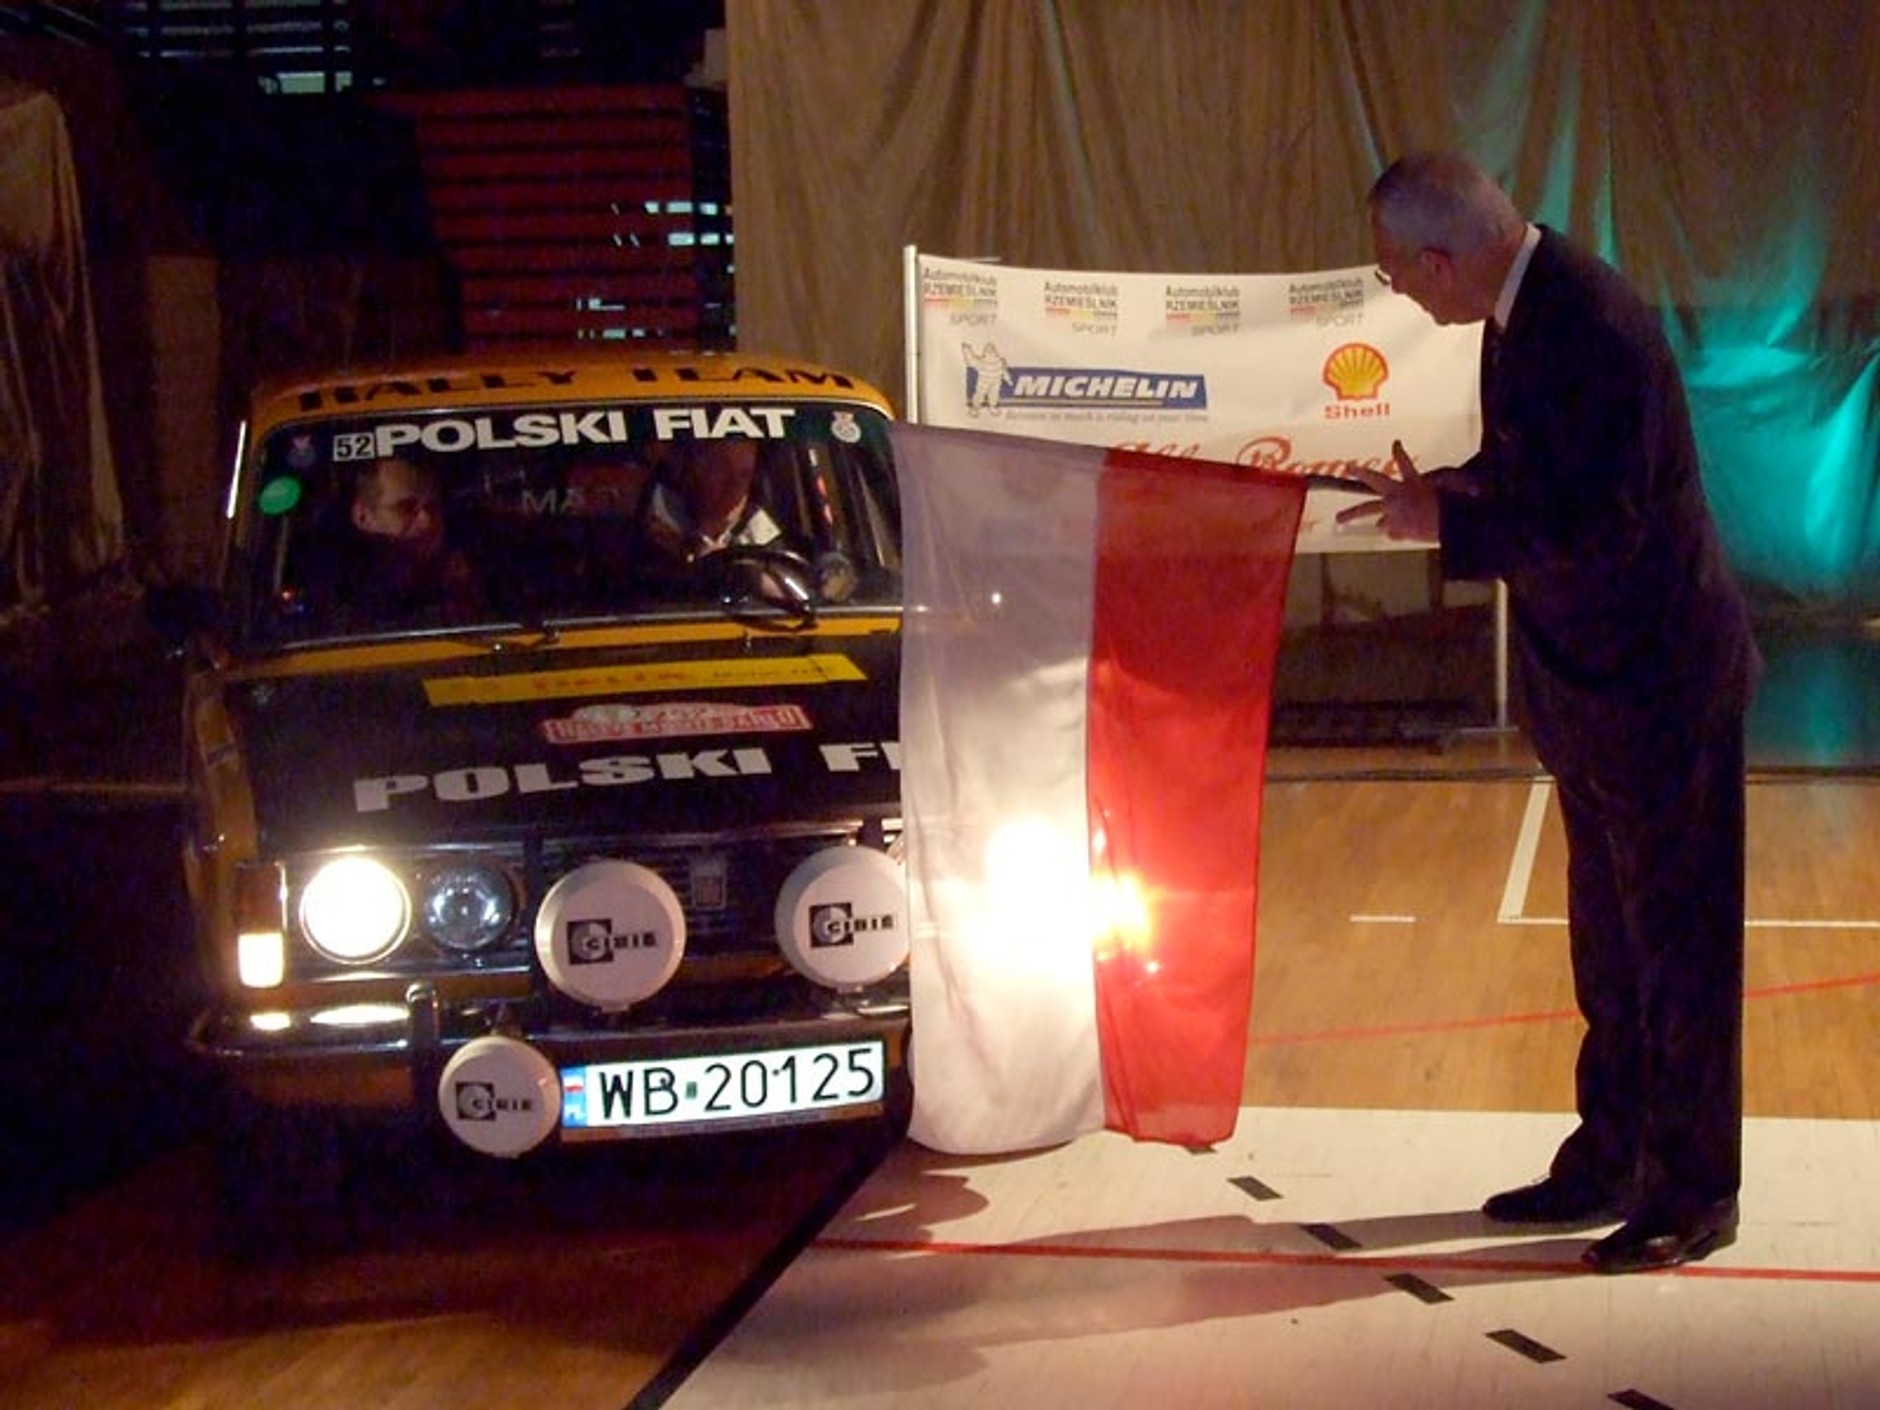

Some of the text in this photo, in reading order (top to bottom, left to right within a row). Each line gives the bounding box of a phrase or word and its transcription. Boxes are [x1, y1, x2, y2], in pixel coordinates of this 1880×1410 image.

[1013, 375, 1198, 399] MICHELIN
[1324, 402, 1391, 421] Shell
[336, 434, 373, 460] 52
[375, 407, 796, 457] POLSKI FIAT
[353, 740, 901, 813] POLSKI FI
[599, 1047, 874, 1119] WB 20125
